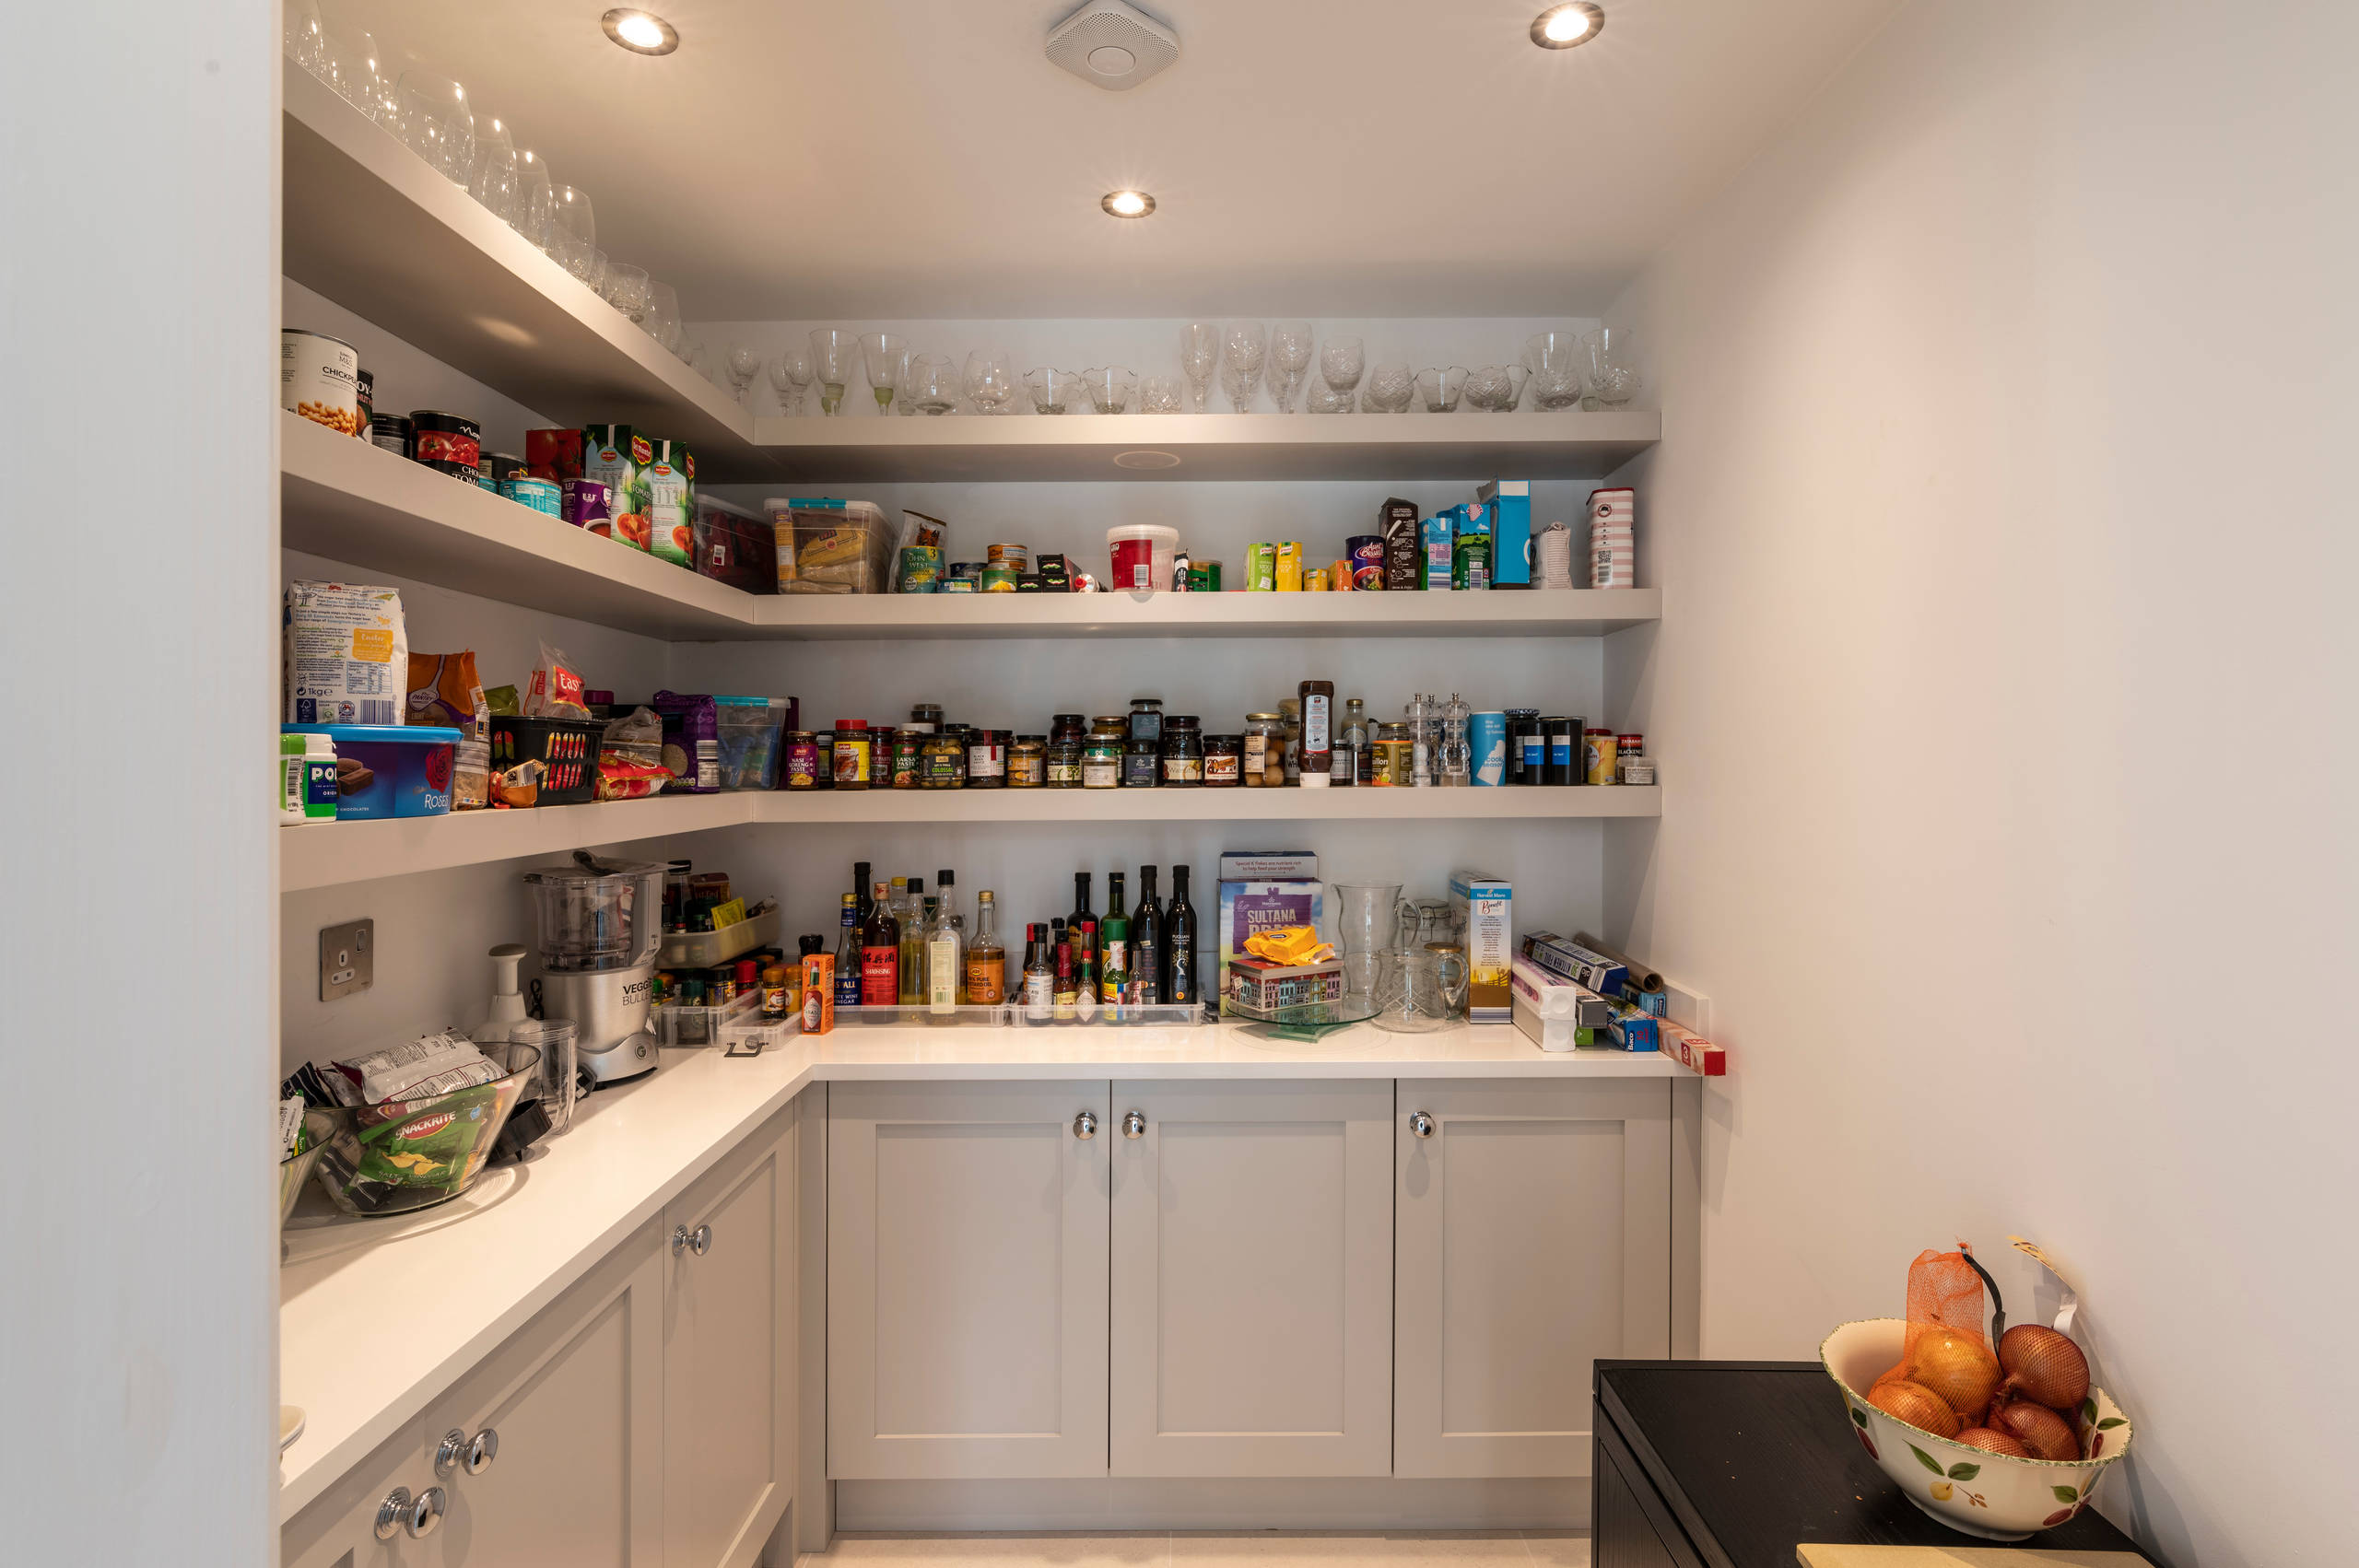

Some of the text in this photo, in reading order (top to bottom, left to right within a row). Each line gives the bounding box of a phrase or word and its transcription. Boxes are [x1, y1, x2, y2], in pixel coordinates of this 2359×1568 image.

[906, 553, 926, 562] JOHN
[308, 688, 323, 696] 1kg
[1247, 908, 1297, 923] SULTANA
[1683, 1047, 1689, 1059] 3
[395, 1110, 457, 1140] SNACKRITE
